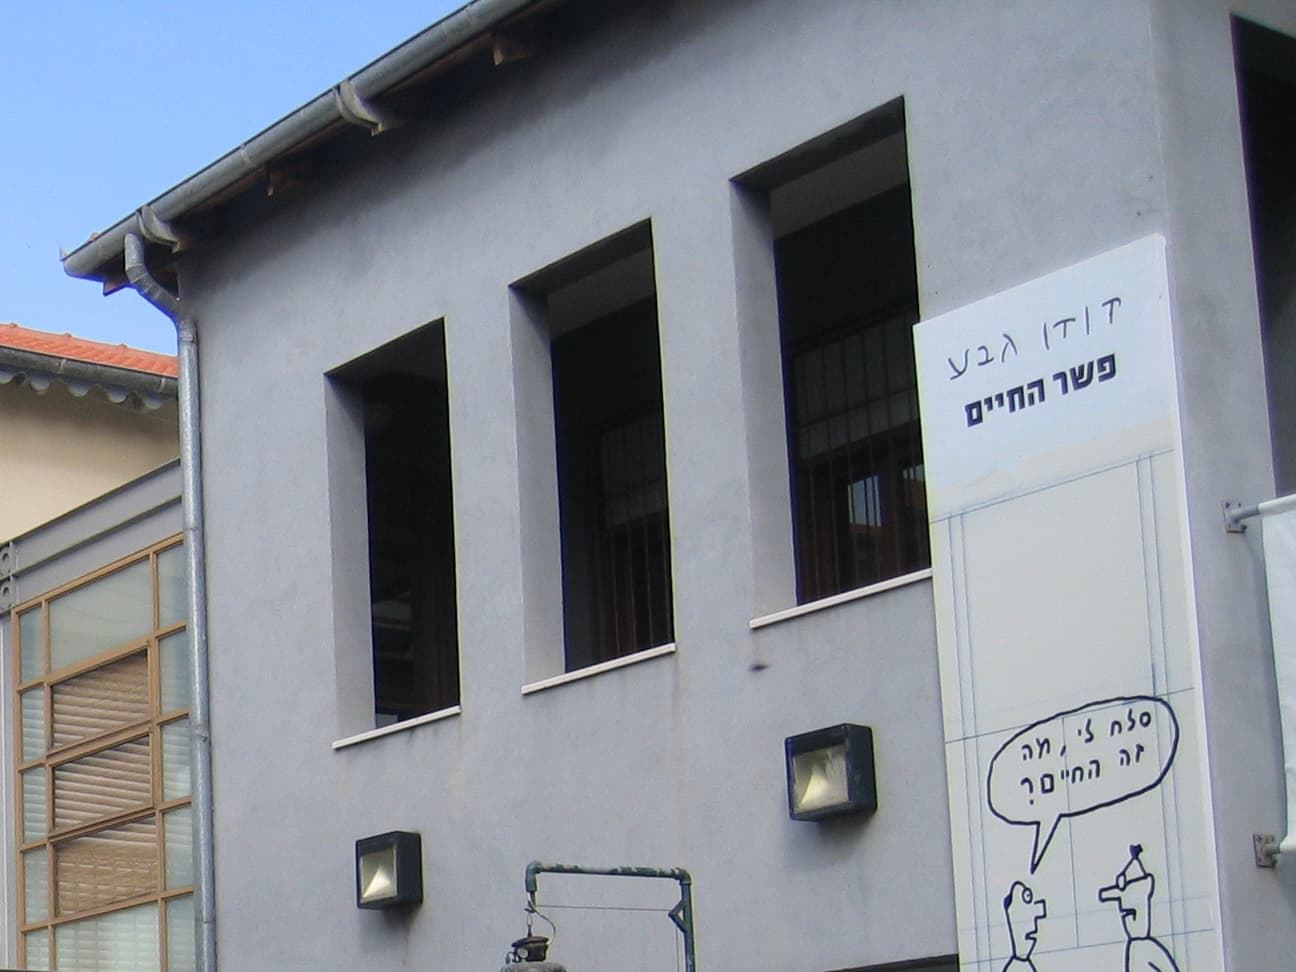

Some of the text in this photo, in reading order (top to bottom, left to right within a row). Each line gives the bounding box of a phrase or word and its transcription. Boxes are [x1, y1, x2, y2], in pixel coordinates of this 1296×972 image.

[948, 296, 1122, 380] דודו גבע
[964, 353, 1117, 427] פשר החיים
[1110, 708, 1152, 736] סלח
[1021, 737, 1051, 761] מה
[1119, 743, 1145, 766] זה
